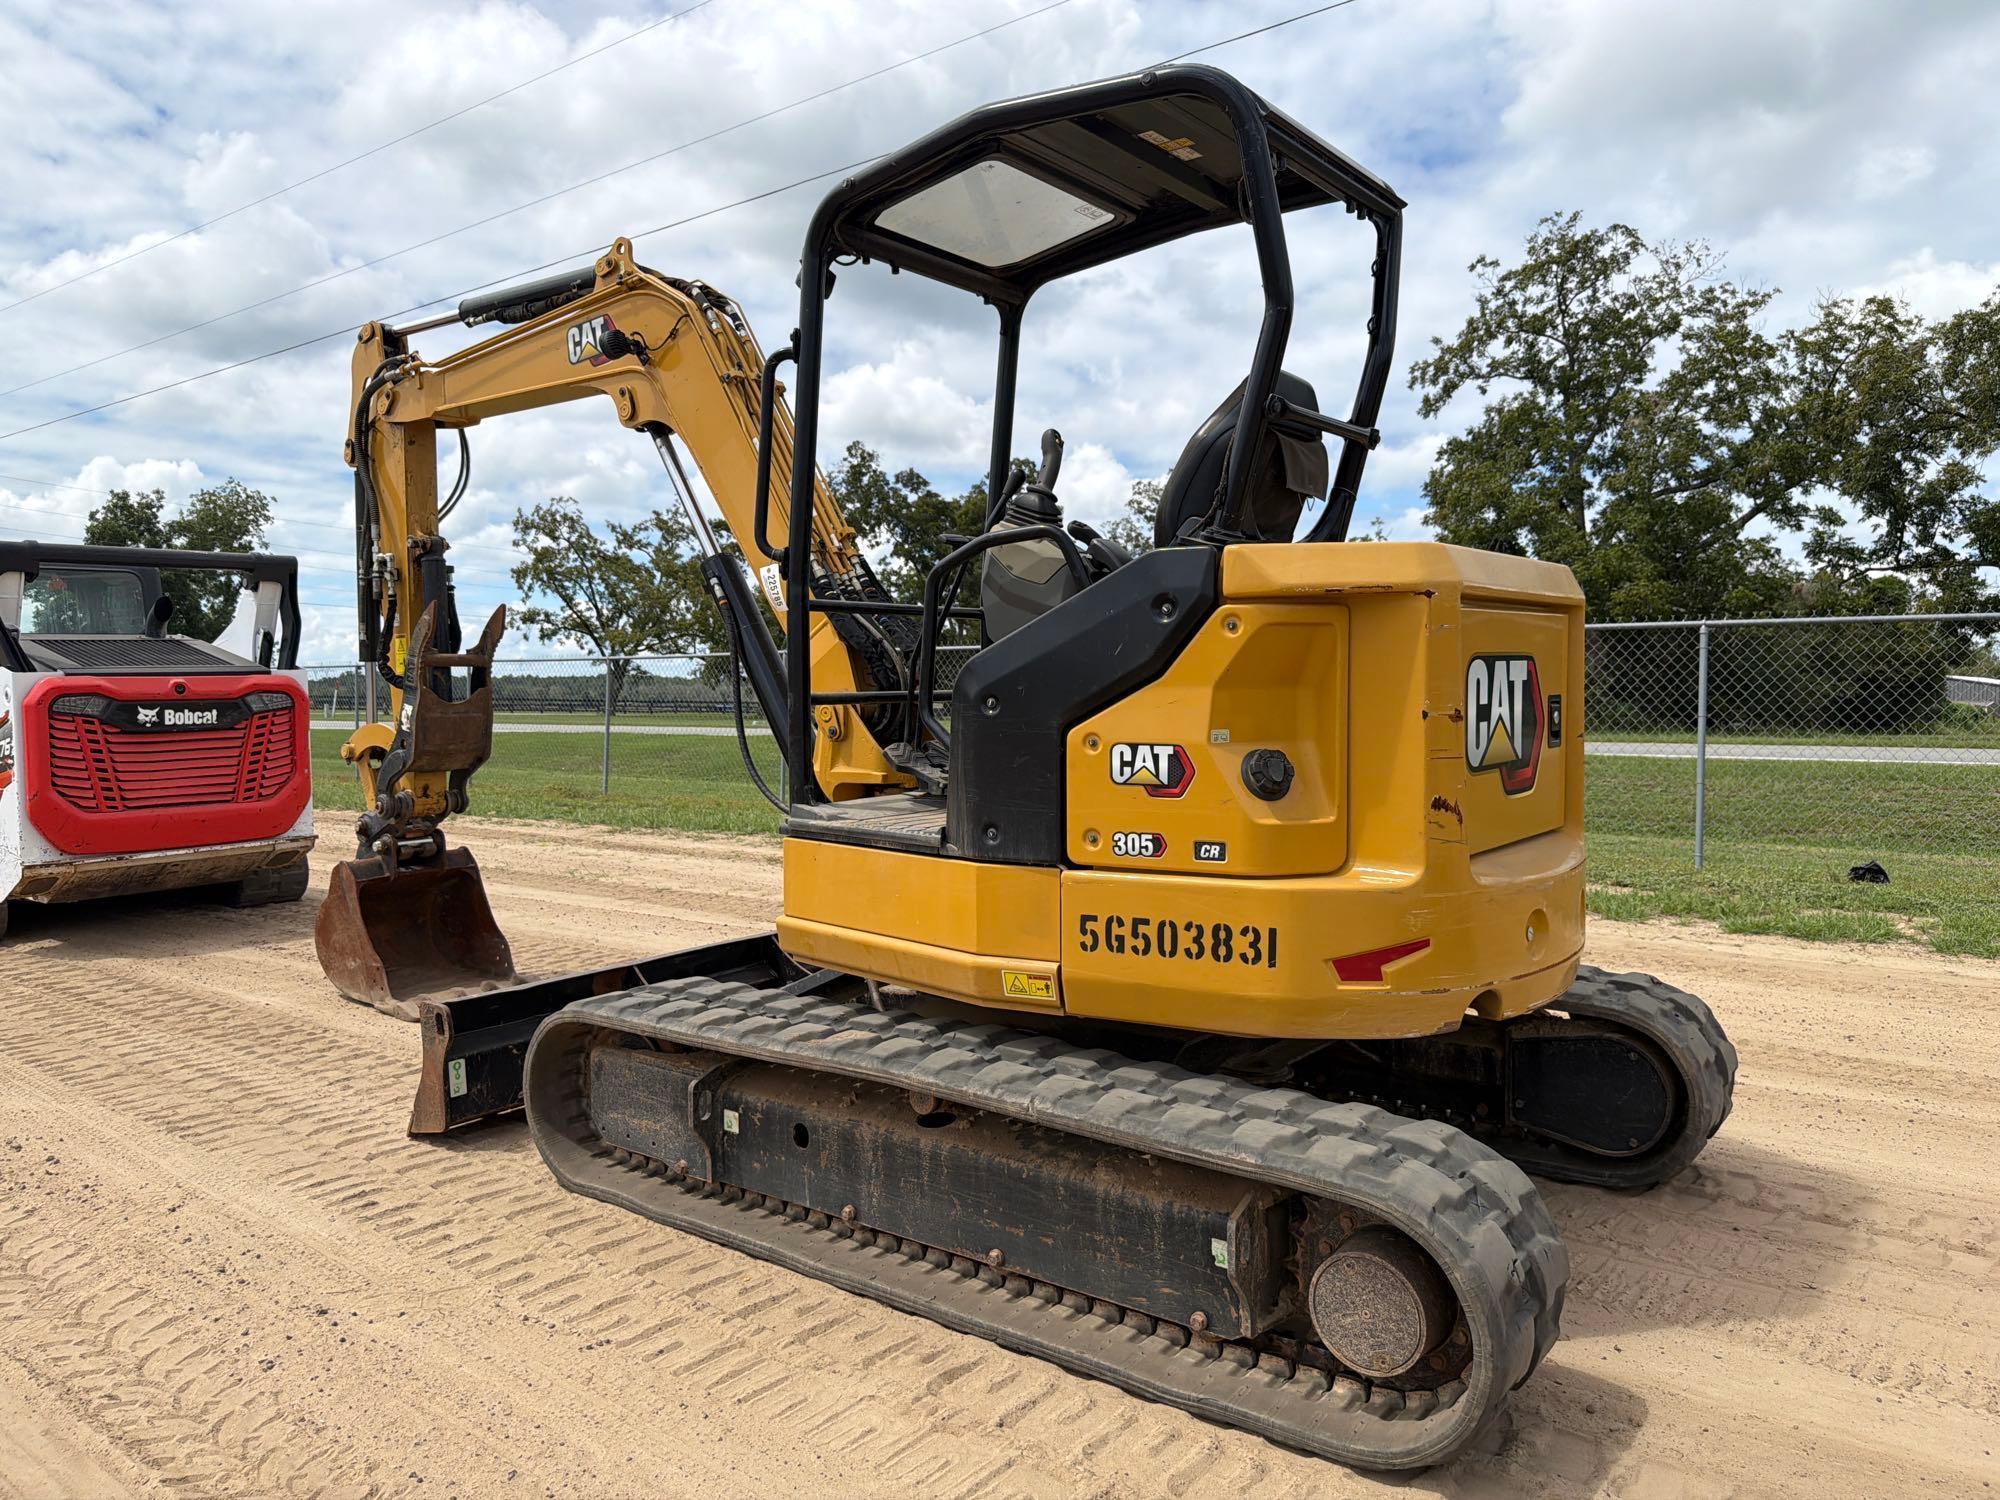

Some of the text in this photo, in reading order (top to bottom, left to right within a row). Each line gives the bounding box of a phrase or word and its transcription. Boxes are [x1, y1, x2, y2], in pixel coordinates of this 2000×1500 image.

[567, 316, 604, 363] CAT
[164, 708, 218, 725] Bobcat
[1467, 659, 1528, 768] CAT
[1111, 744, 1174, 785] CAT
[1113, 832, 1154, 857] 305
[1200, 844, 1220, 858] CR
